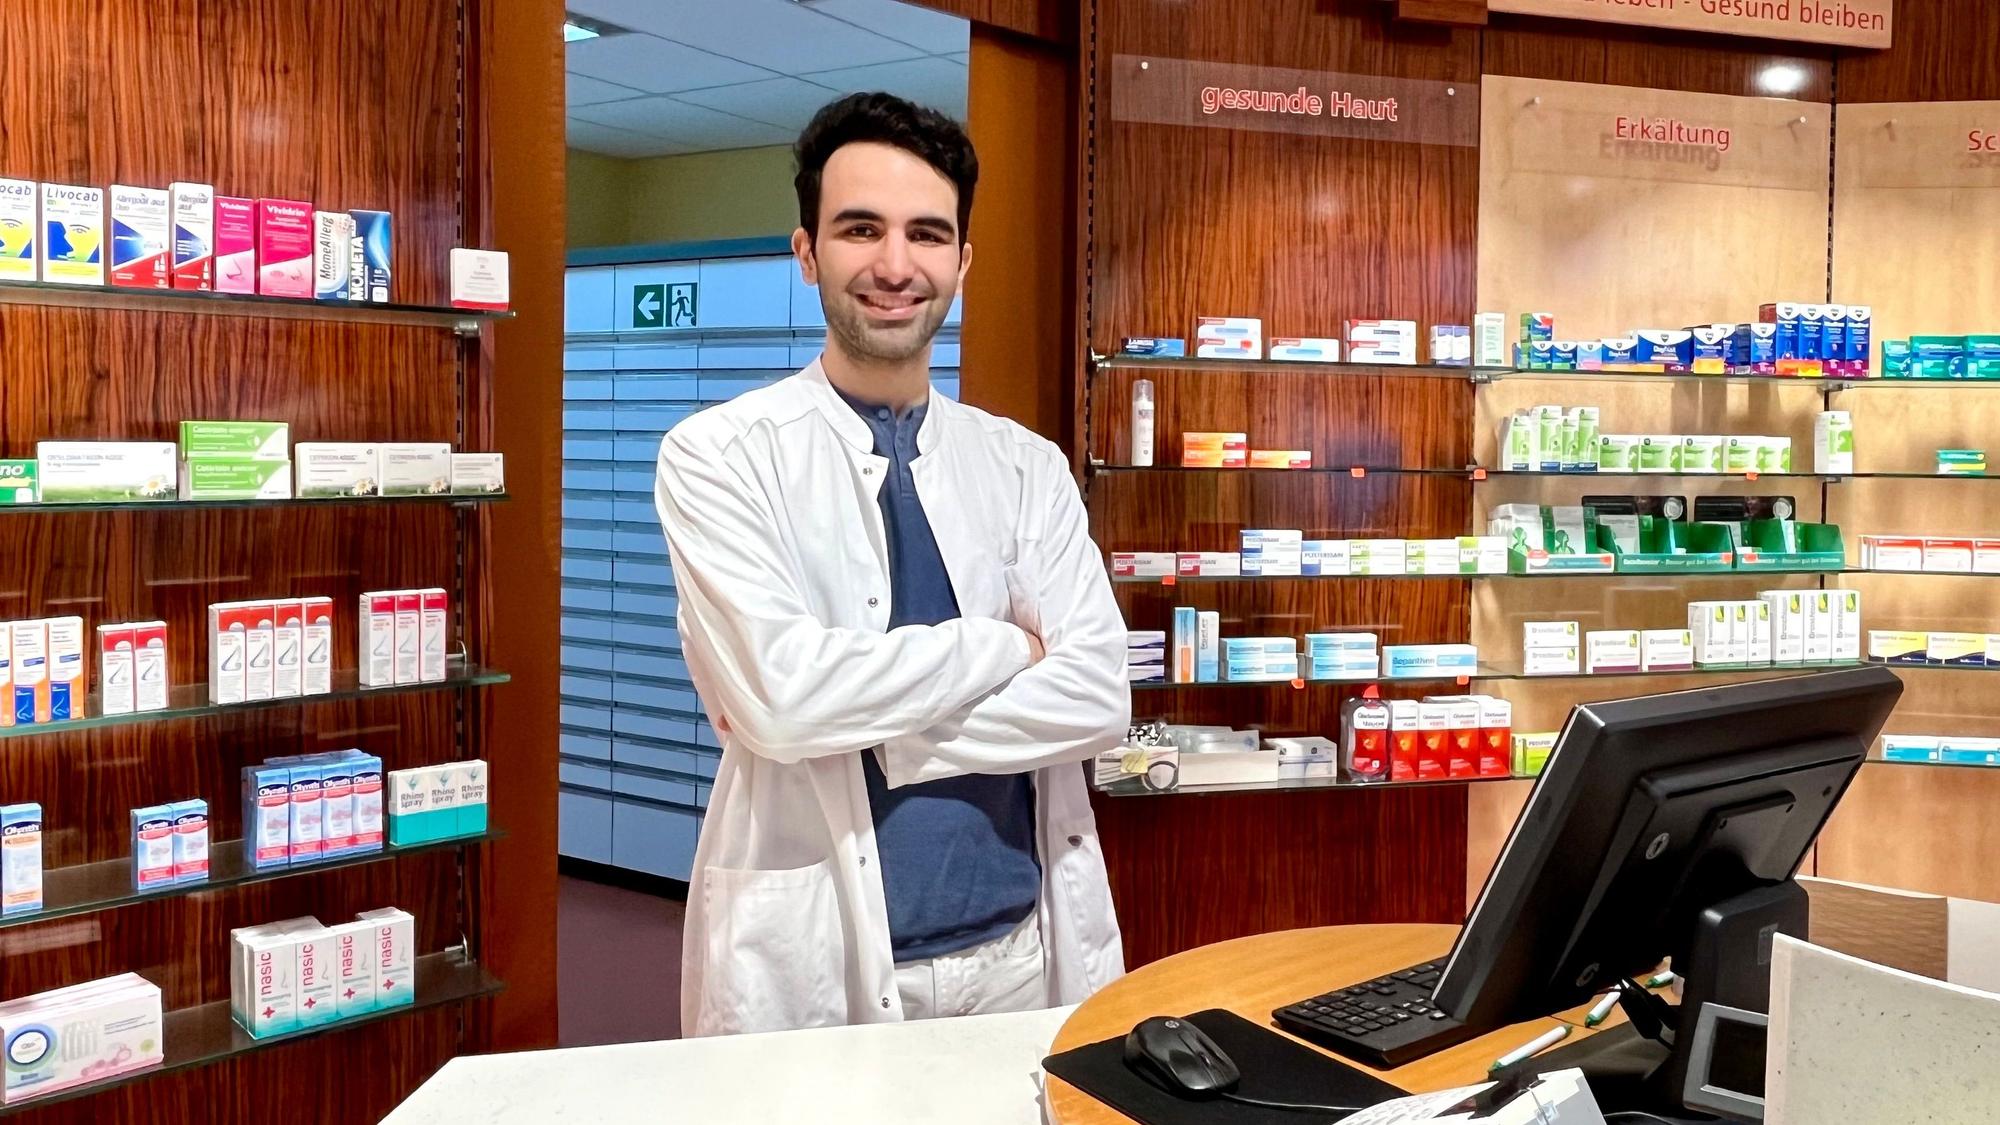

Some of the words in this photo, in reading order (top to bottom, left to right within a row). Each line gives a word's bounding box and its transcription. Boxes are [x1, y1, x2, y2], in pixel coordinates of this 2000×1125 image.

[1701, 0, 1789, 21] Gesund
[1800, 1, 1884, 31] bleiben
[1201, 86, 1323, 114] gesunde
[1331, 92, 1398, 121] Haut
[1615, 117, 1731, 151] Erkältung
[47, 187, 99, 202] Livocab
[267, 204, 306, 217] Vividrin
[319, 216, 335, 280] MomeAllerg
[1392, 656, 1435, 666] Bepanthen
[292, 781, 320, 792] Olynth
[338, 935, 353, 977] nasic
[377, 926, 392, 968] nasic
[256, 951, 272, 996] nasic
[298, 943, 314, 986] nasic
